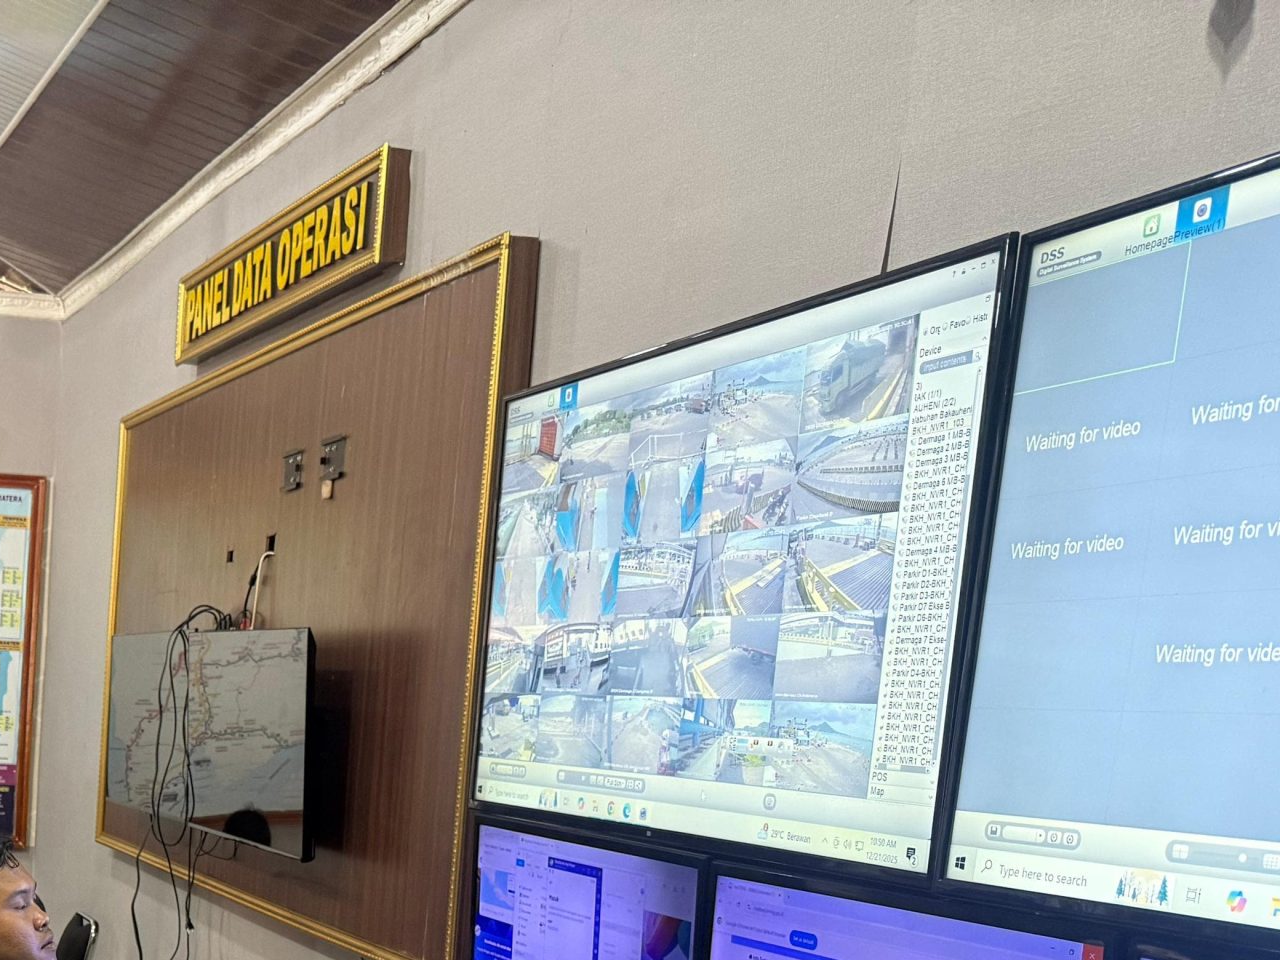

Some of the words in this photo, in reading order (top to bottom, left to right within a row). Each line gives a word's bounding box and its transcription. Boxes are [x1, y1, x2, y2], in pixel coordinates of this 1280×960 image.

[1124, 236, 1173, 256] Homepage
[1173, 218, 1227, 243] Preview(1)
[1040, 247, 1065, 265] DSS
[186, 270, 231, 343] PANEL
[233, 240, 272, 316] DATA
[277, 181, 370, 291] OPERASI
[919, 346, 942, 358] Device
[1191, 402, 1254, 425] Waiting
[918, 434, 946, 446] Dermaga
[1025, 430, 1076, 452] Waiting
[1079, 426, 1097, 443] for
[1103, 420, 1141, 440] video
[916, 446, 944, 457] Dermaga
[915, 457, 943, 468] Dermaga
[913, 480, 940, 490] Dermaga
[1173, 523, 1234, 545] Waiting
[1239, 520, 1263, 540] for
[906, 548, 932, 557] Dermaga
[1011, 540, 1060, 560] Waiting
[1063, 537, 1083, 555] for
[1086, 534, 1124, 553] video
[903, 570, 921, 579] Parkir
[902, 581, 919, 590] Parkir
[901, 592, 918, 600] Parkir
[899, 603, 917, 612] Parkir
[898, 614, 915, 622] Parkir
[896, 636, 922, 645] Dermaga
[1155, 644, 1215, 667] Waiting
[1220, 643, 1243, 662] for
[892, 669, 909, 677] Parkir
[872, 772, 888, 782] POS
[870, 786, 884, 796] Map
[770, 829, 784, 840] 29°C
[787, 832, 811, 844] Berawan
[886, 839, 897, 848] AM
[999, 864, 1020, 878] Type
[1021, 867, 1042, 881] here
[1043, 871, 1053, 883] to
[1056, 873, 1087, 887] search
